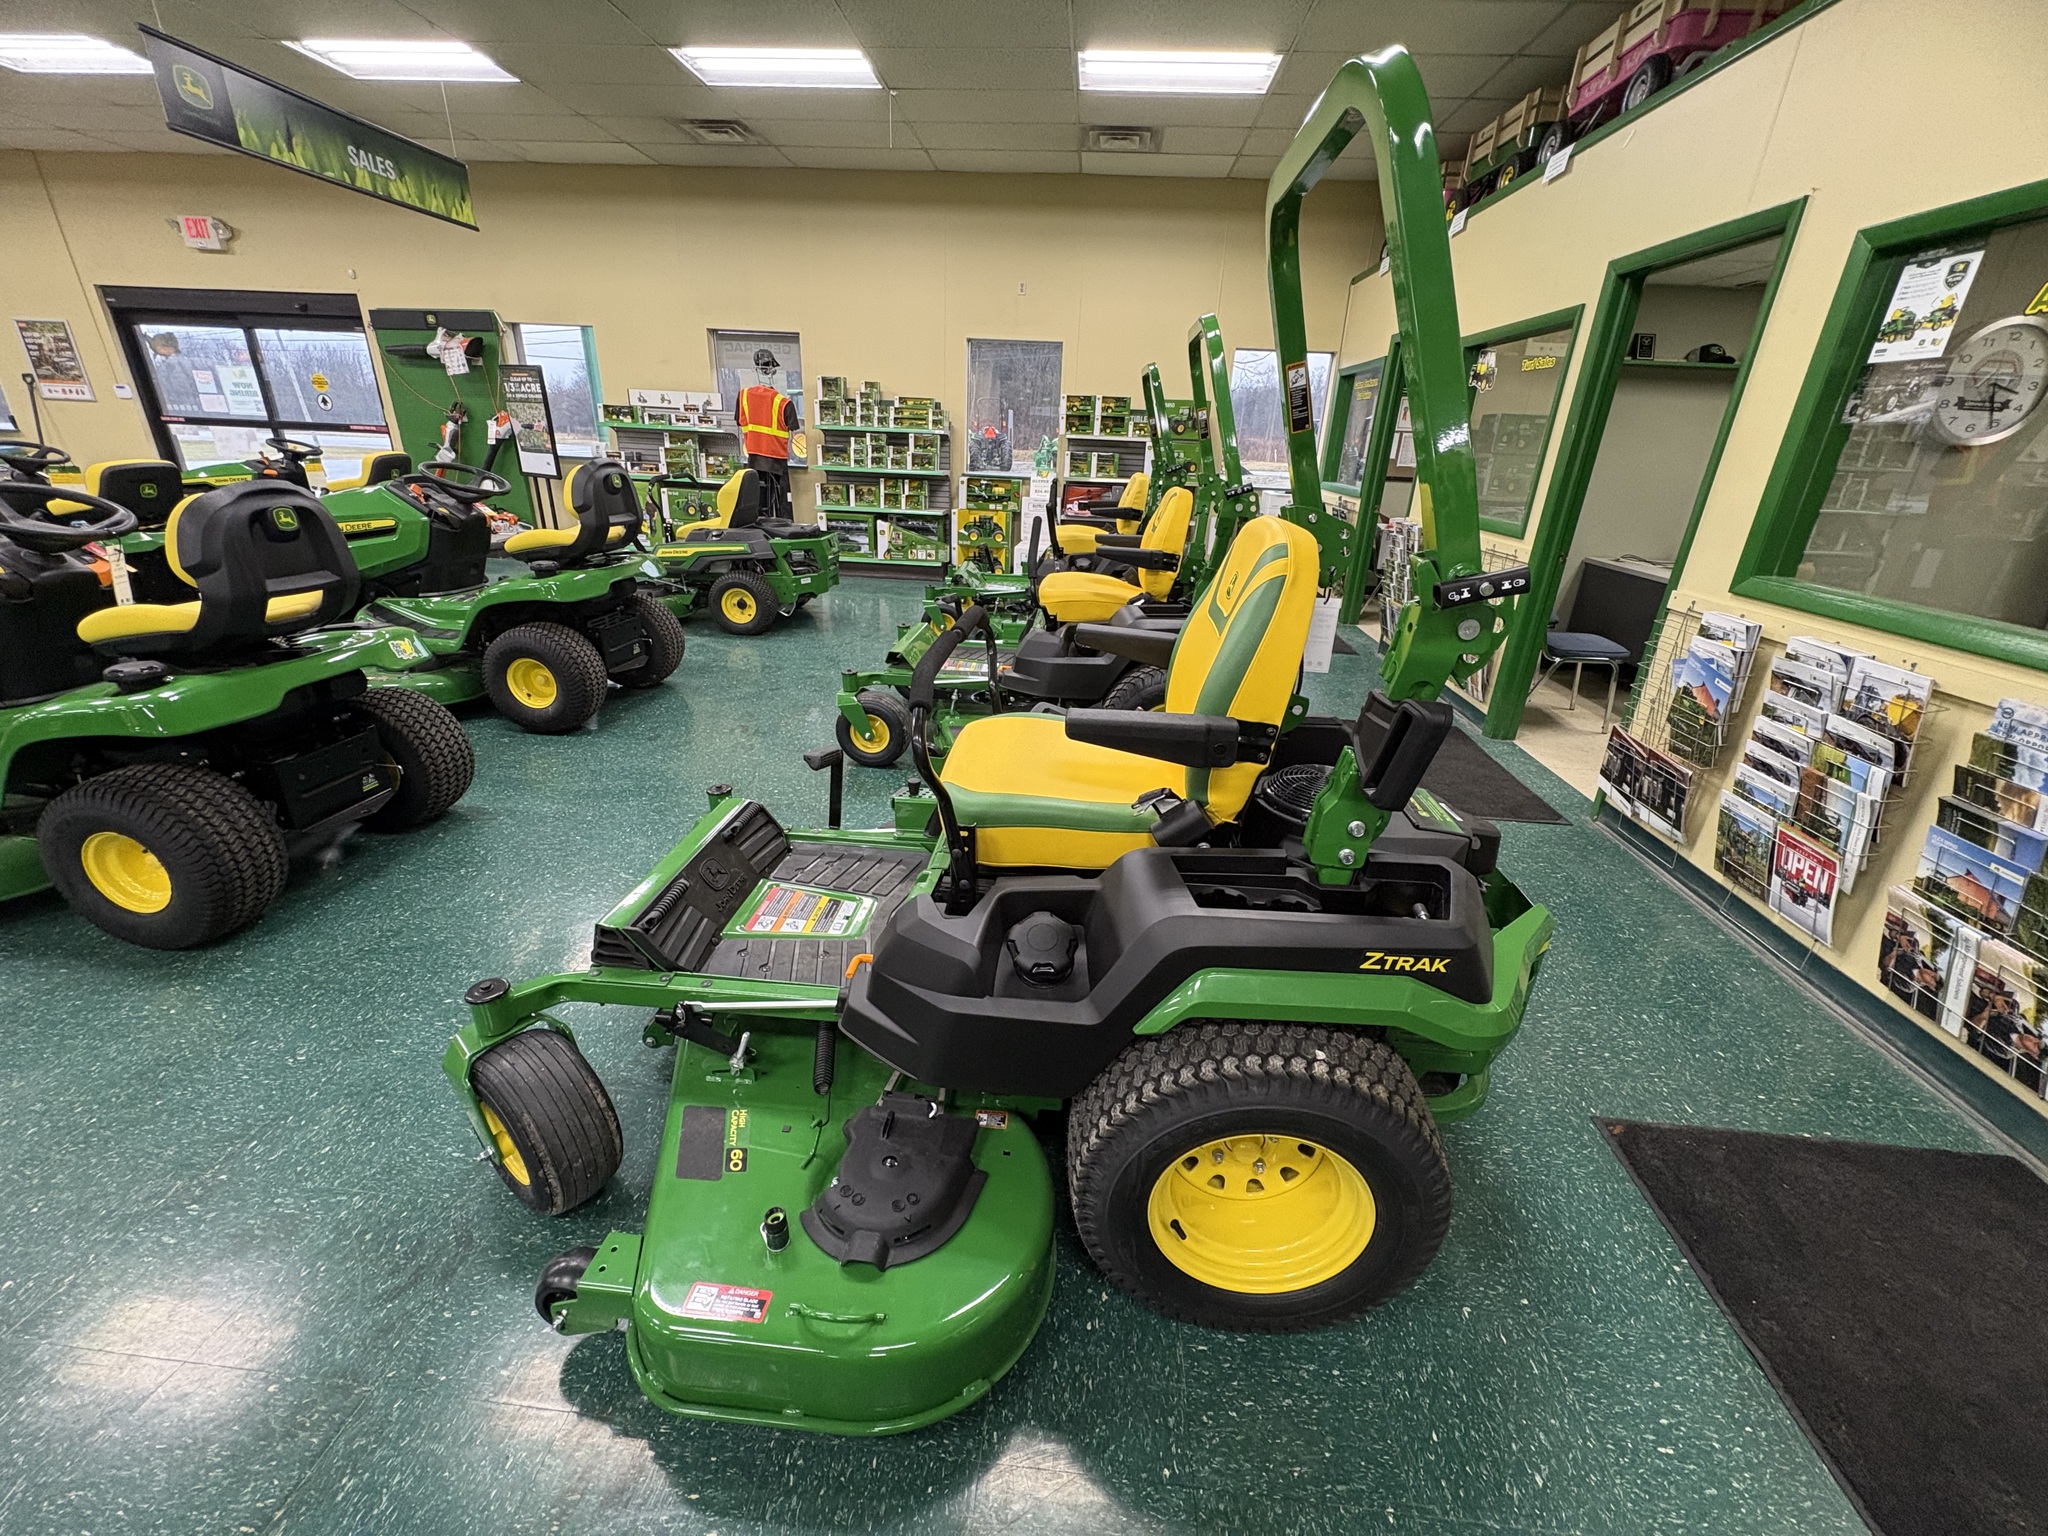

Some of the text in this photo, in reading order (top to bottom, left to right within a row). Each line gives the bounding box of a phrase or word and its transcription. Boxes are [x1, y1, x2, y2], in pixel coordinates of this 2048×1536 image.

[347, 145, 396, 180] SALES
[184, 217, 210, 240] EXIT
[2009, 331, 2023, 342] 12
[1983, 338, 1995, 347] 11
[2030, 340, 2035, 349] 1
[1521, 356, 1556, 371] Turf Sales
[1959, 354, 1972, 363] 10
[2033, 358, 2045, 368] 2
[520, 382, 542, 393] ACRE
[2028, 382, 2039, 391] 3
[1939, 400, 1950, 408] 8
[2013, 404, 2023, 412] 4
[1948, 416, 1959, 425] 7
[1965, 423, 1976, 433] 6
[345, 523, 372, 531] DEERE
[1998, 720, 2048, 742] NEW APPR
[1780, 844, 1829, 893] OPEN
[1359, 952, 1452, 973] ZTRAK
[739, 1109, 747, 1128] HIGH
[729, 1109, 739, 1146] CAPACITY
[730, 1149, 743, 1171] 60
[734, 1288, 759, 1297] DANGER
